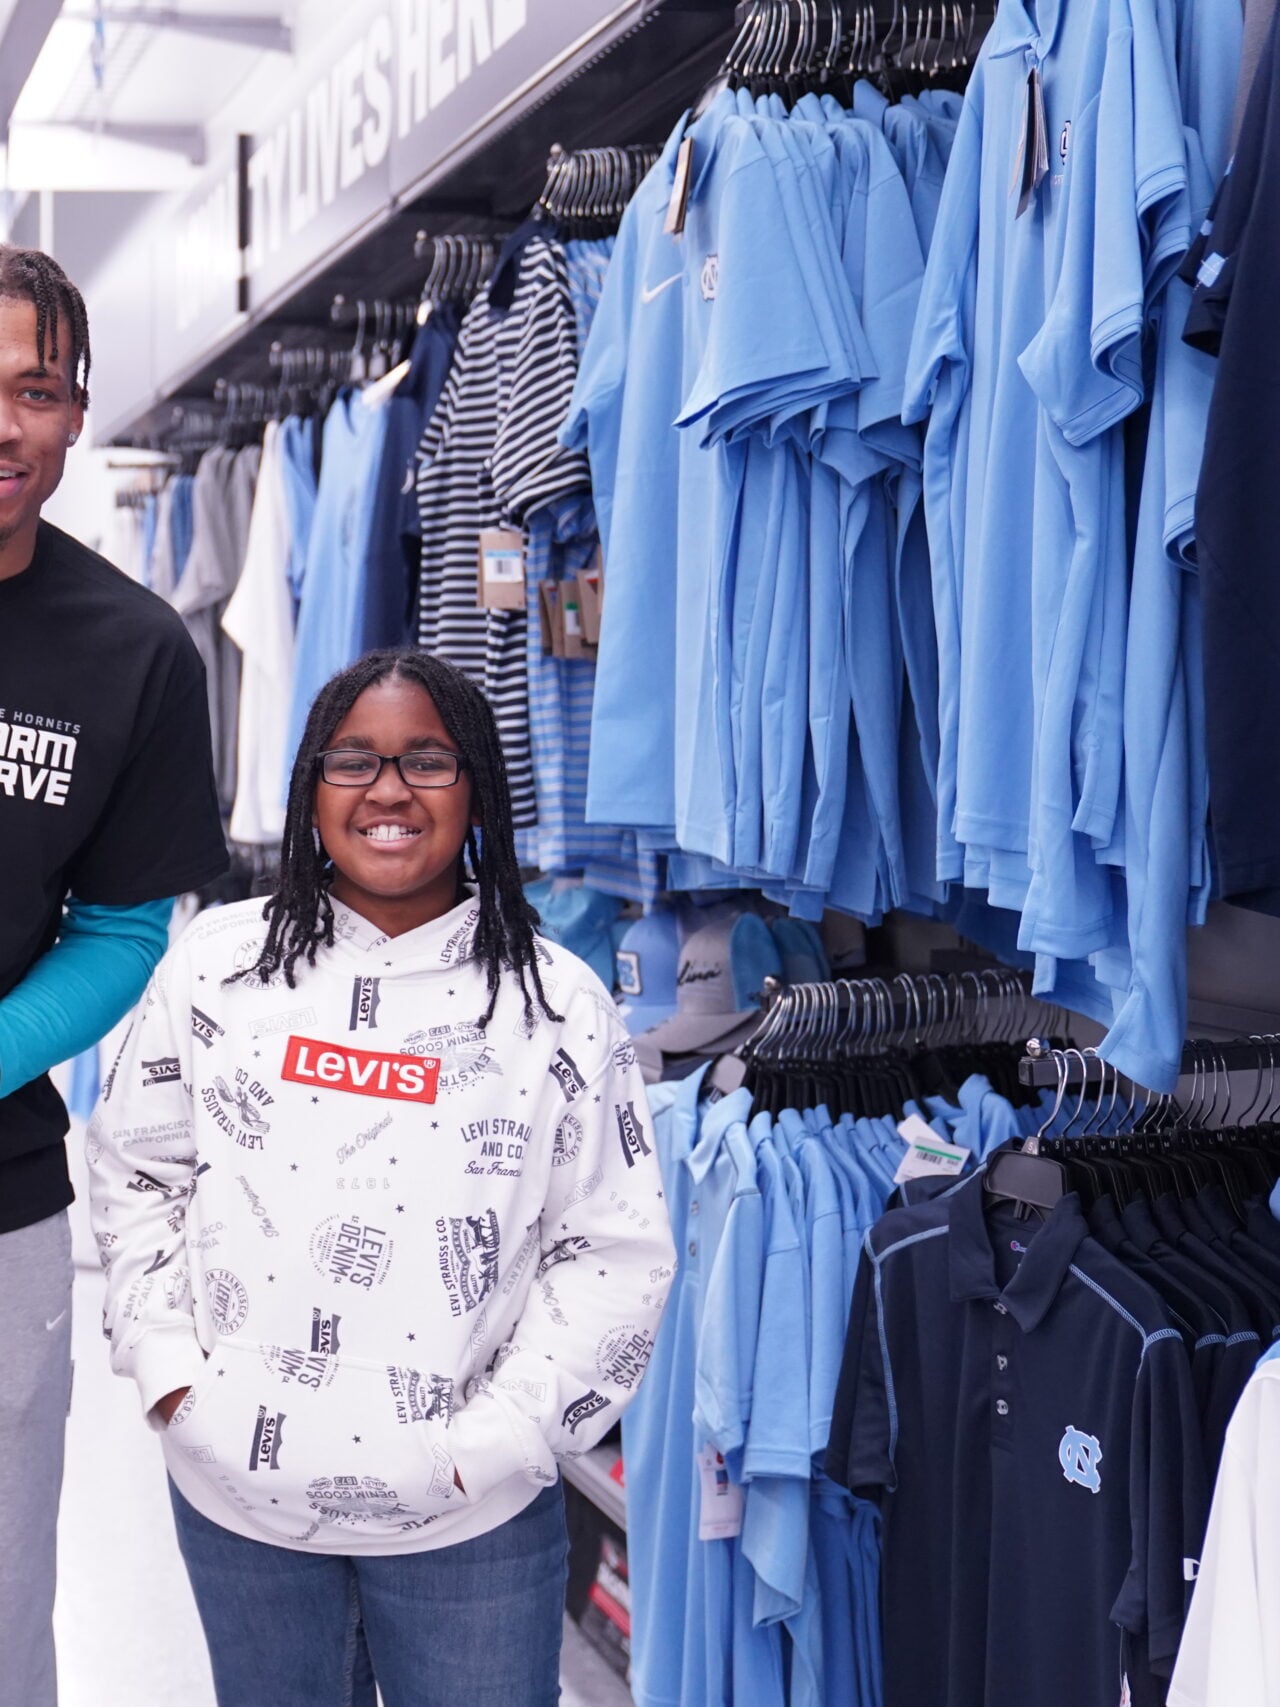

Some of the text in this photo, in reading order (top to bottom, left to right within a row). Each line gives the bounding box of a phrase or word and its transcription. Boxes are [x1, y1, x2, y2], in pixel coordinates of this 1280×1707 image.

[288, 13, 393, 237] LIVES
[12, 710, 82, 735] HORNETS
[399, 1030, 487, 1057] DENIM GOODS
[248, 1080, 275, 1107] AND
[201, 1087, 265, 1151] LEVI STRAUSS
[460, 1118, 533, 1143] LEVI STRAU
[336, 1110, 394, 1165] The Original
[480, 1141, 524, 1160] AND CO.
[464, 1160, 522, 1178] San Franc
[259, 1216, 280, 1239] The
[328, 1222, 361, 1279] DENIM
[349, 1225, 387, 1292] LEVI'S
[437, 1244, 457, 1291] STRAUSS
[449, 1293, 462, 1318] LEVI
[278, 1349, 306, 1377] NIM
[606, 1333, 647, 1376] DENIM
[297, 1355, 327, 1392] VI'S
[386, 1365, 408, 1424] LEVI STRAU
[305, 1490, 398, 1500] DENIM GOODS
